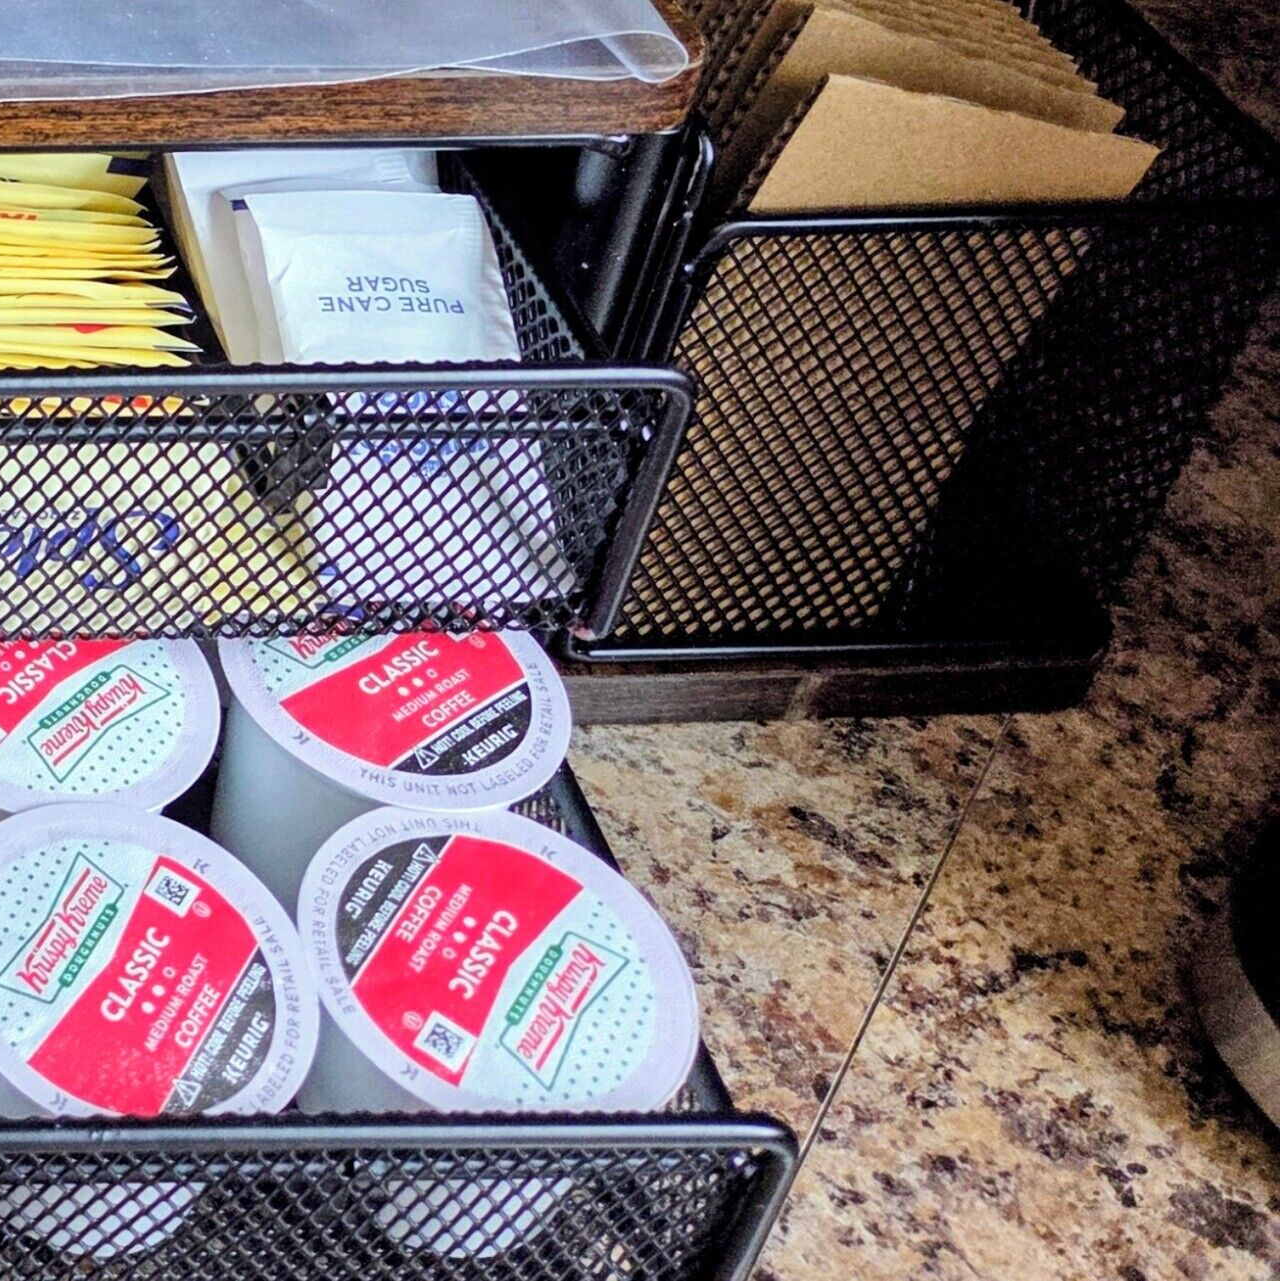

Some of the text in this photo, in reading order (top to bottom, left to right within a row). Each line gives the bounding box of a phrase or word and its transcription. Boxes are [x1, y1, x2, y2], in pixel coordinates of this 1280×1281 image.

[318, 296, 464, 314] PURE CANE
[346, 277, 429, 293] SUGAR
[358, 639, 439, 695] CLASSIC
[391, 668, 470, 722] MEDIUM ROAST
[422, 689, 476, 729] COFFEE
[462, 724, 518, 767] KEURIG
[345, 859, 393, 920] KEURIG
[394, 885, 444, 944] COFFEE
[100, 927, 171, 1022] CLASSIC
[448, 910, 519, 1001] CLASSIC
[144, 953, 208, 1052] MEDIUM ROAST
[174, 983, 221, 1048] COFFEE
[221, 1013, 269, 1085] KEURIG
